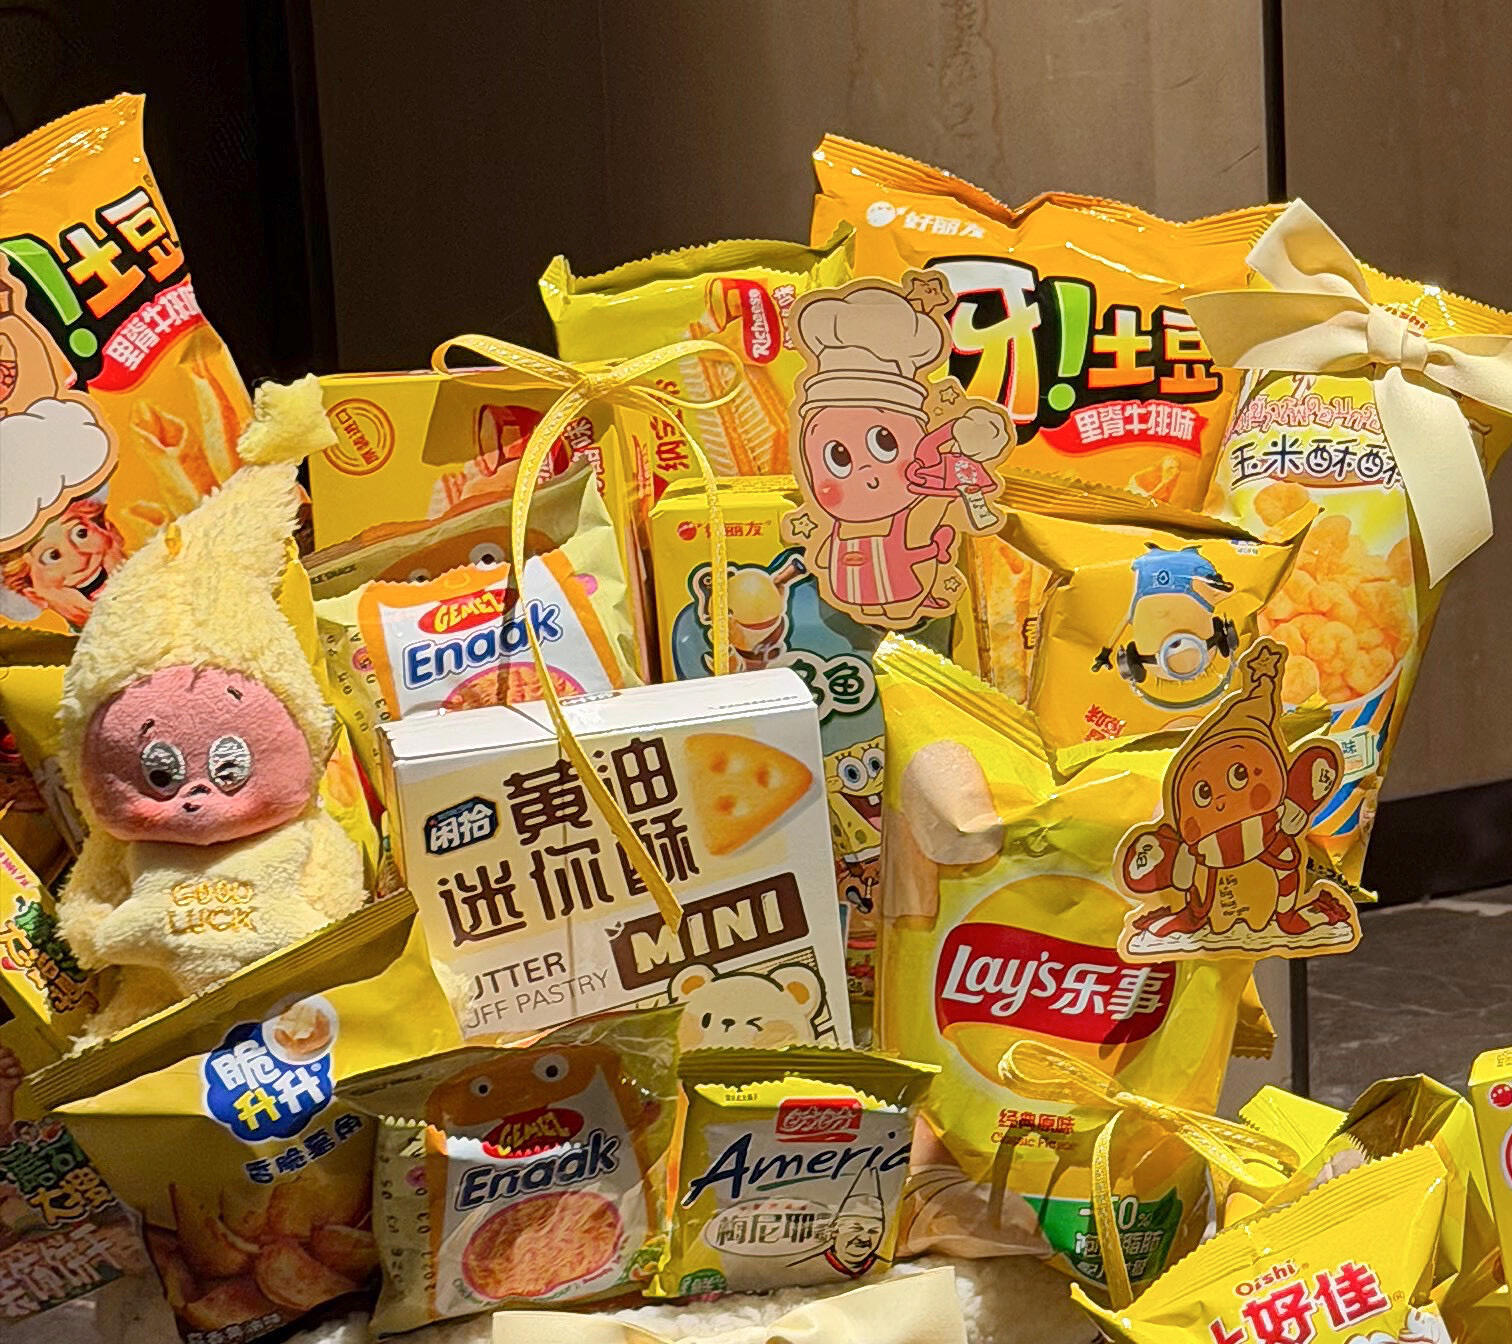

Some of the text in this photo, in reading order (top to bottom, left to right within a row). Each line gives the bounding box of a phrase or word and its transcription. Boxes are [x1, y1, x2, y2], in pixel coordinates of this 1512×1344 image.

[904, 212, 985, 239] 好丽友
[1074, 403, 1196, 444] 里脊牛排味
[1231, 433, 1404, 490] 玉米酥酥
[404, 600, 563, 689] Enaak
[504, 736, 679, 846] 黄油
[429, 804, 494, 852] 闲拾
[170, 880, 255, 907] GOOD
[437, 808, 700, 948] 迷你酥
[167, 907, 258, 936] LUCK
[631, 890, 784, 974] MINI
[467, 969, 610, 1029] UFF PASTRY
[474, 952, 567, 1001] UTTER
[942, 944, 1171, 1022] Lay's 乐事
[455, 1130, 622, 1211] Enaak
[1235, 1258, 1298, 1298] Oishi
